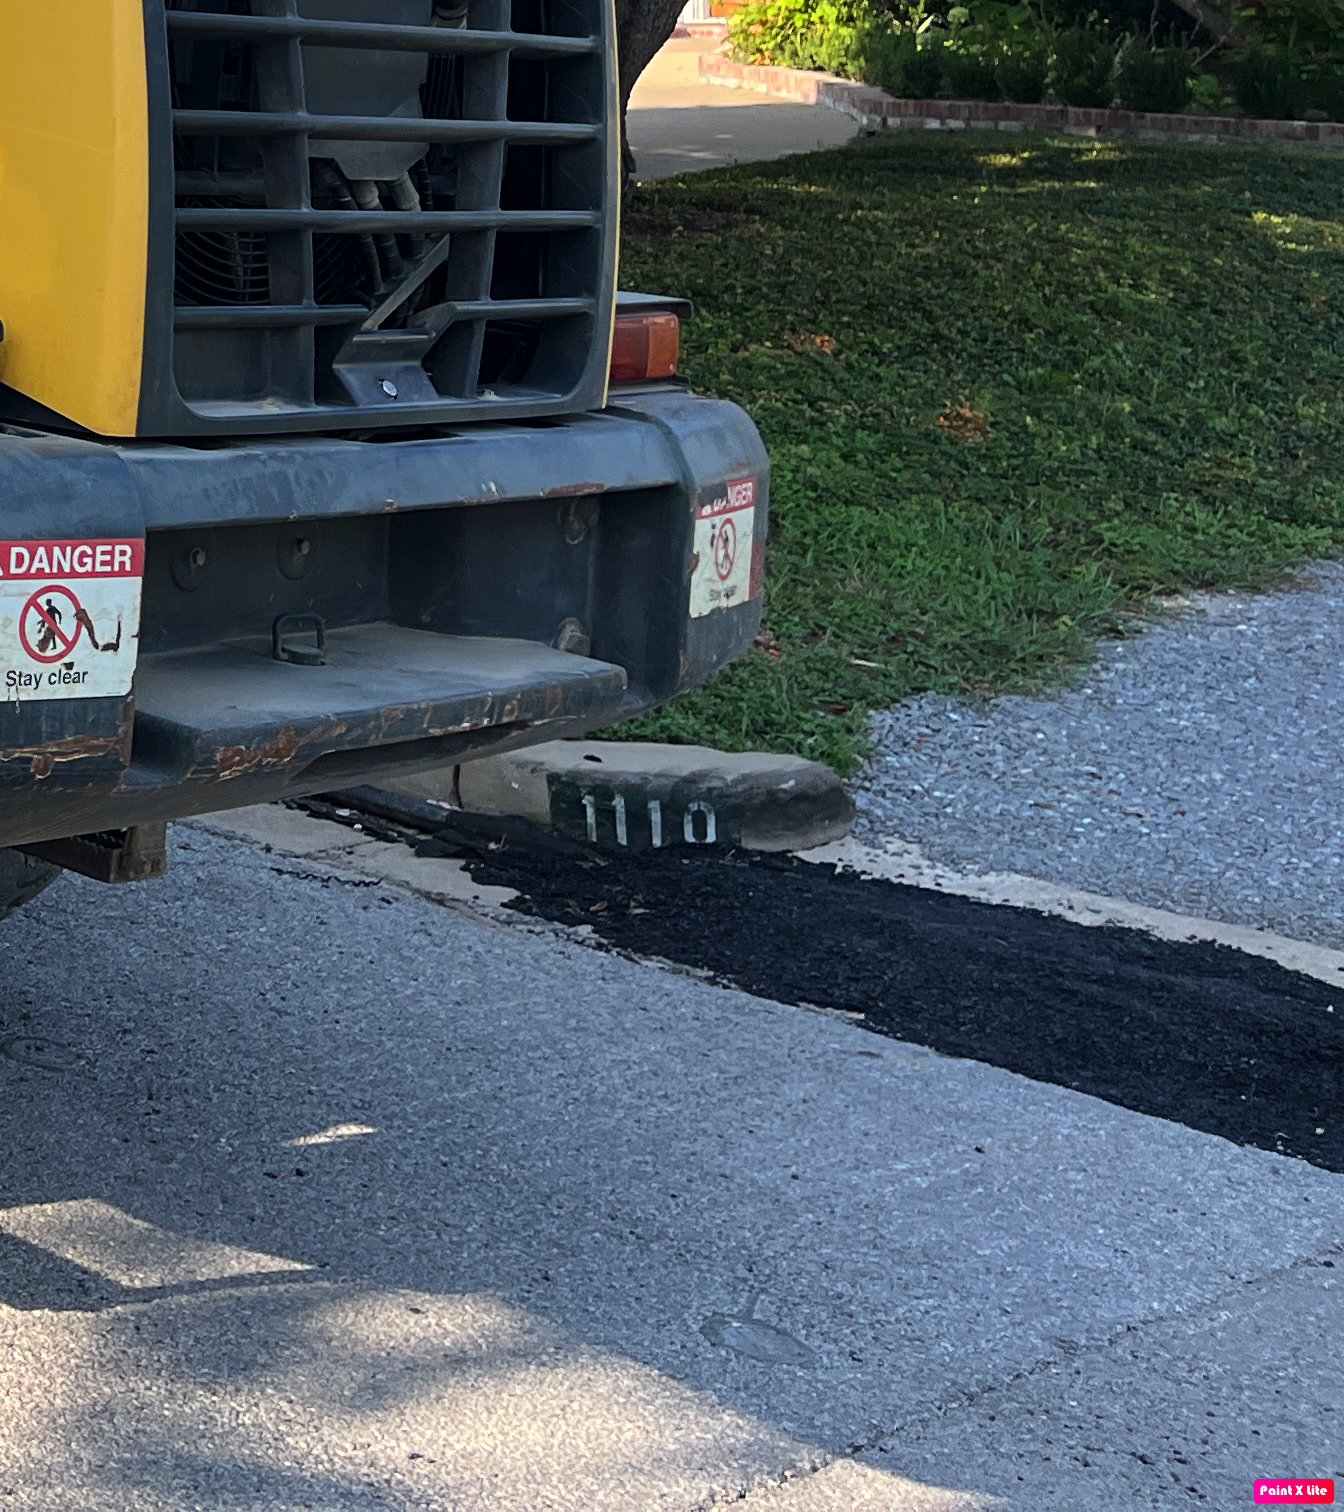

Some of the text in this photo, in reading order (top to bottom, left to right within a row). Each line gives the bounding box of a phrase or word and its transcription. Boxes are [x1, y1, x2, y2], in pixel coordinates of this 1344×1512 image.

[9, 544, 133, 575] DANGER
[5, 669, 89, 690] Stay clear
[581, 791, 717, 849] 1110
